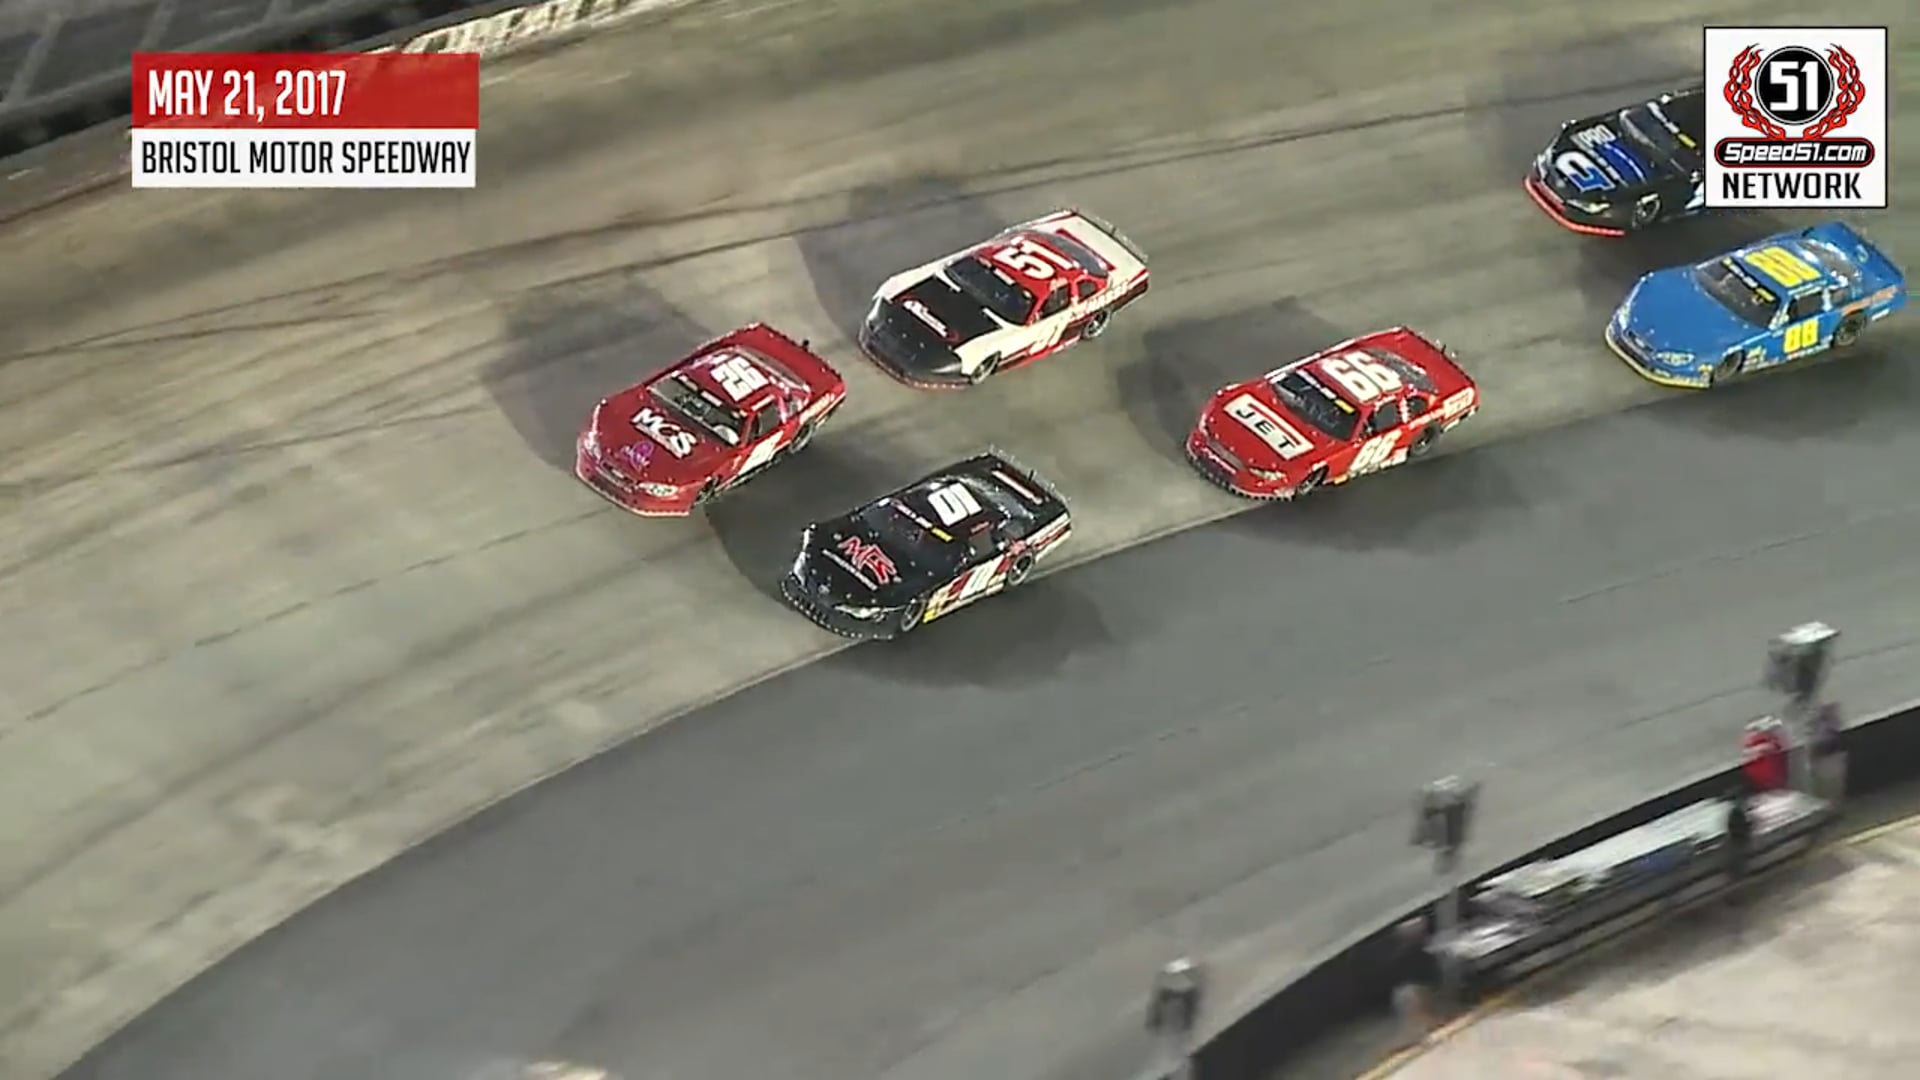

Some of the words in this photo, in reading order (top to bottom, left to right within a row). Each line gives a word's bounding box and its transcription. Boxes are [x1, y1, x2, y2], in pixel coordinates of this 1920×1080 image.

[994, 240, 1073, 280] 51
[1322, 350, 1403, 402] 66
[631, 407, 697, 455] MCS
[1235, 407, 1298, 452] JET
[1350, 429, 1403, 469] 66
[928, 482, 982, 527] 01
